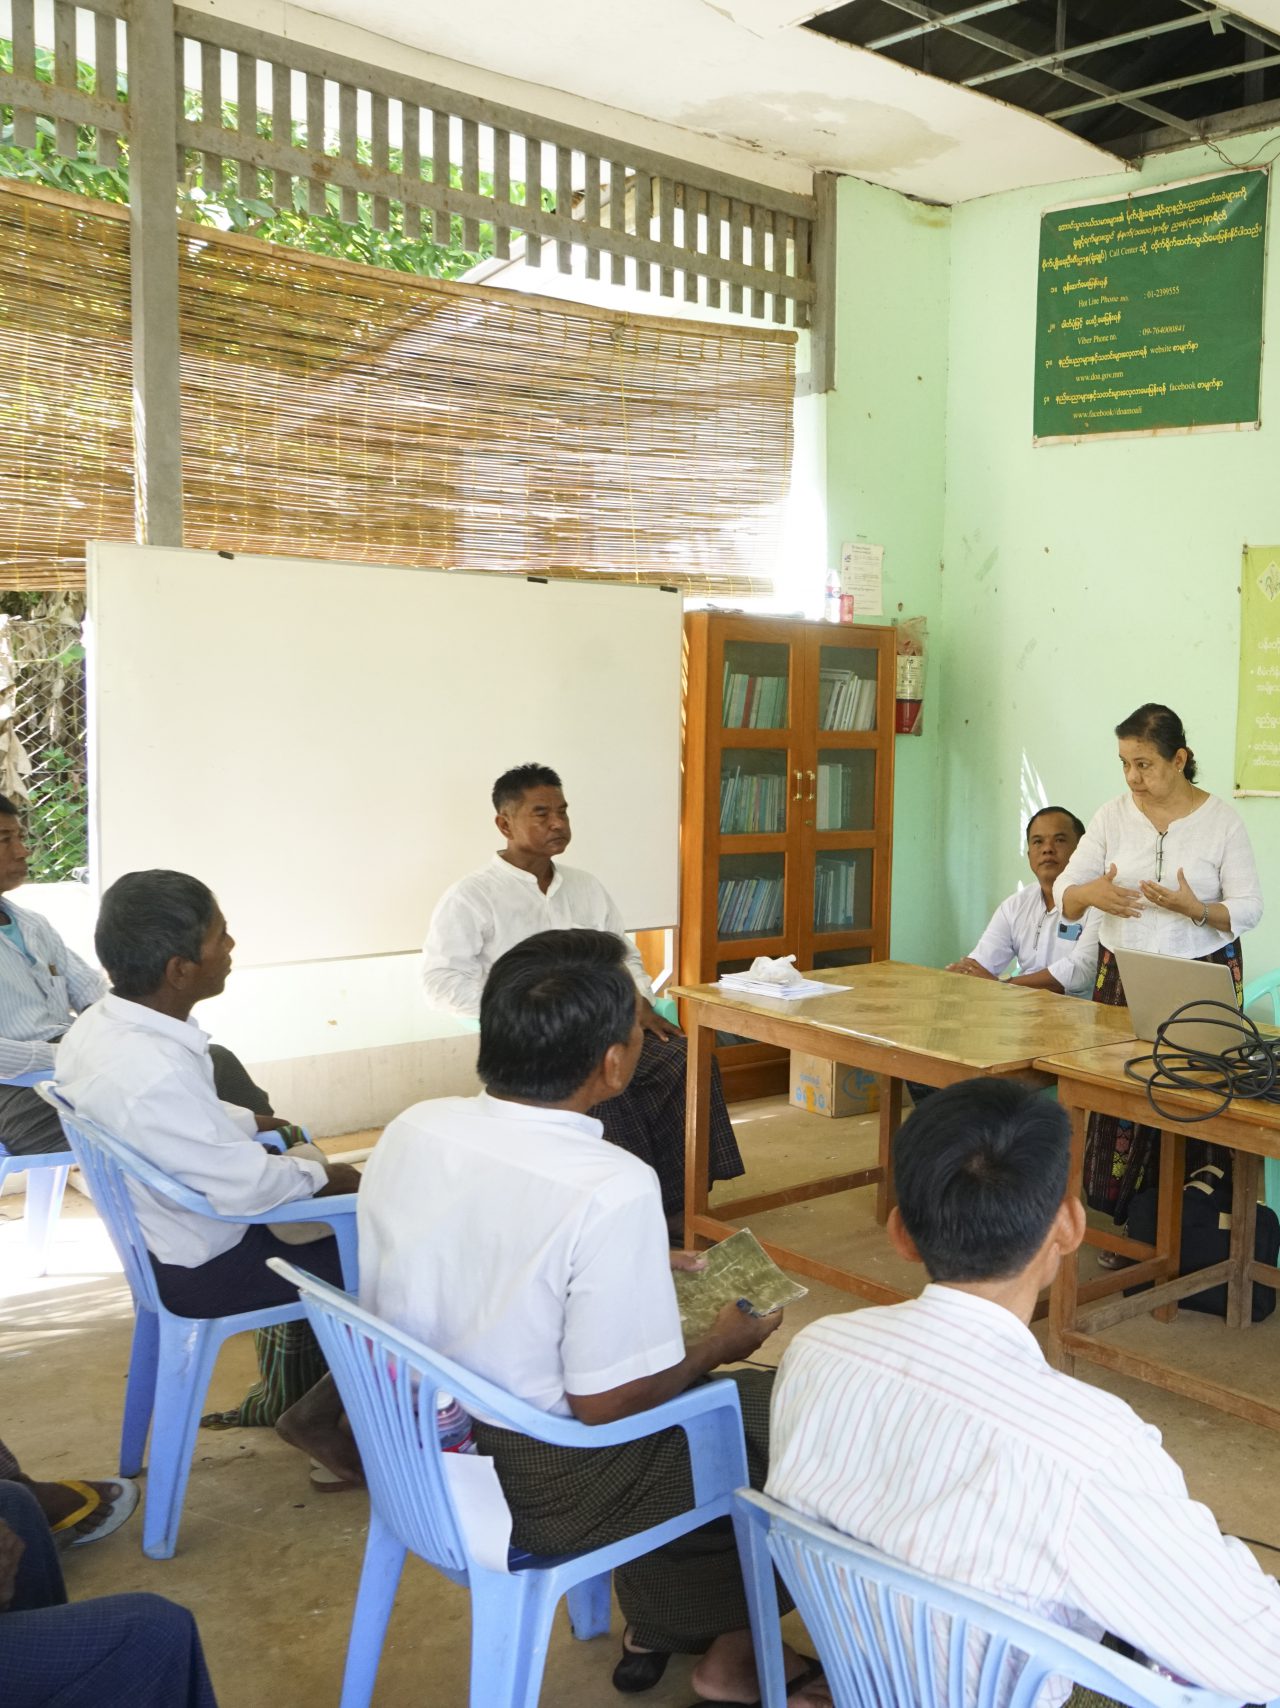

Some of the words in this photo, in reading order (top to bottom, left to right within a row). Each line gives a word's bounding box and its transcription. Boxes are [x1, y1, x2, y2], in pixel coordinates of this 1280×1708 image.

[1100, 295, 1119, 304] Phone
[1077, 336, 1092, 345] Viber
[1093, 335, 1109, 344] Phone
